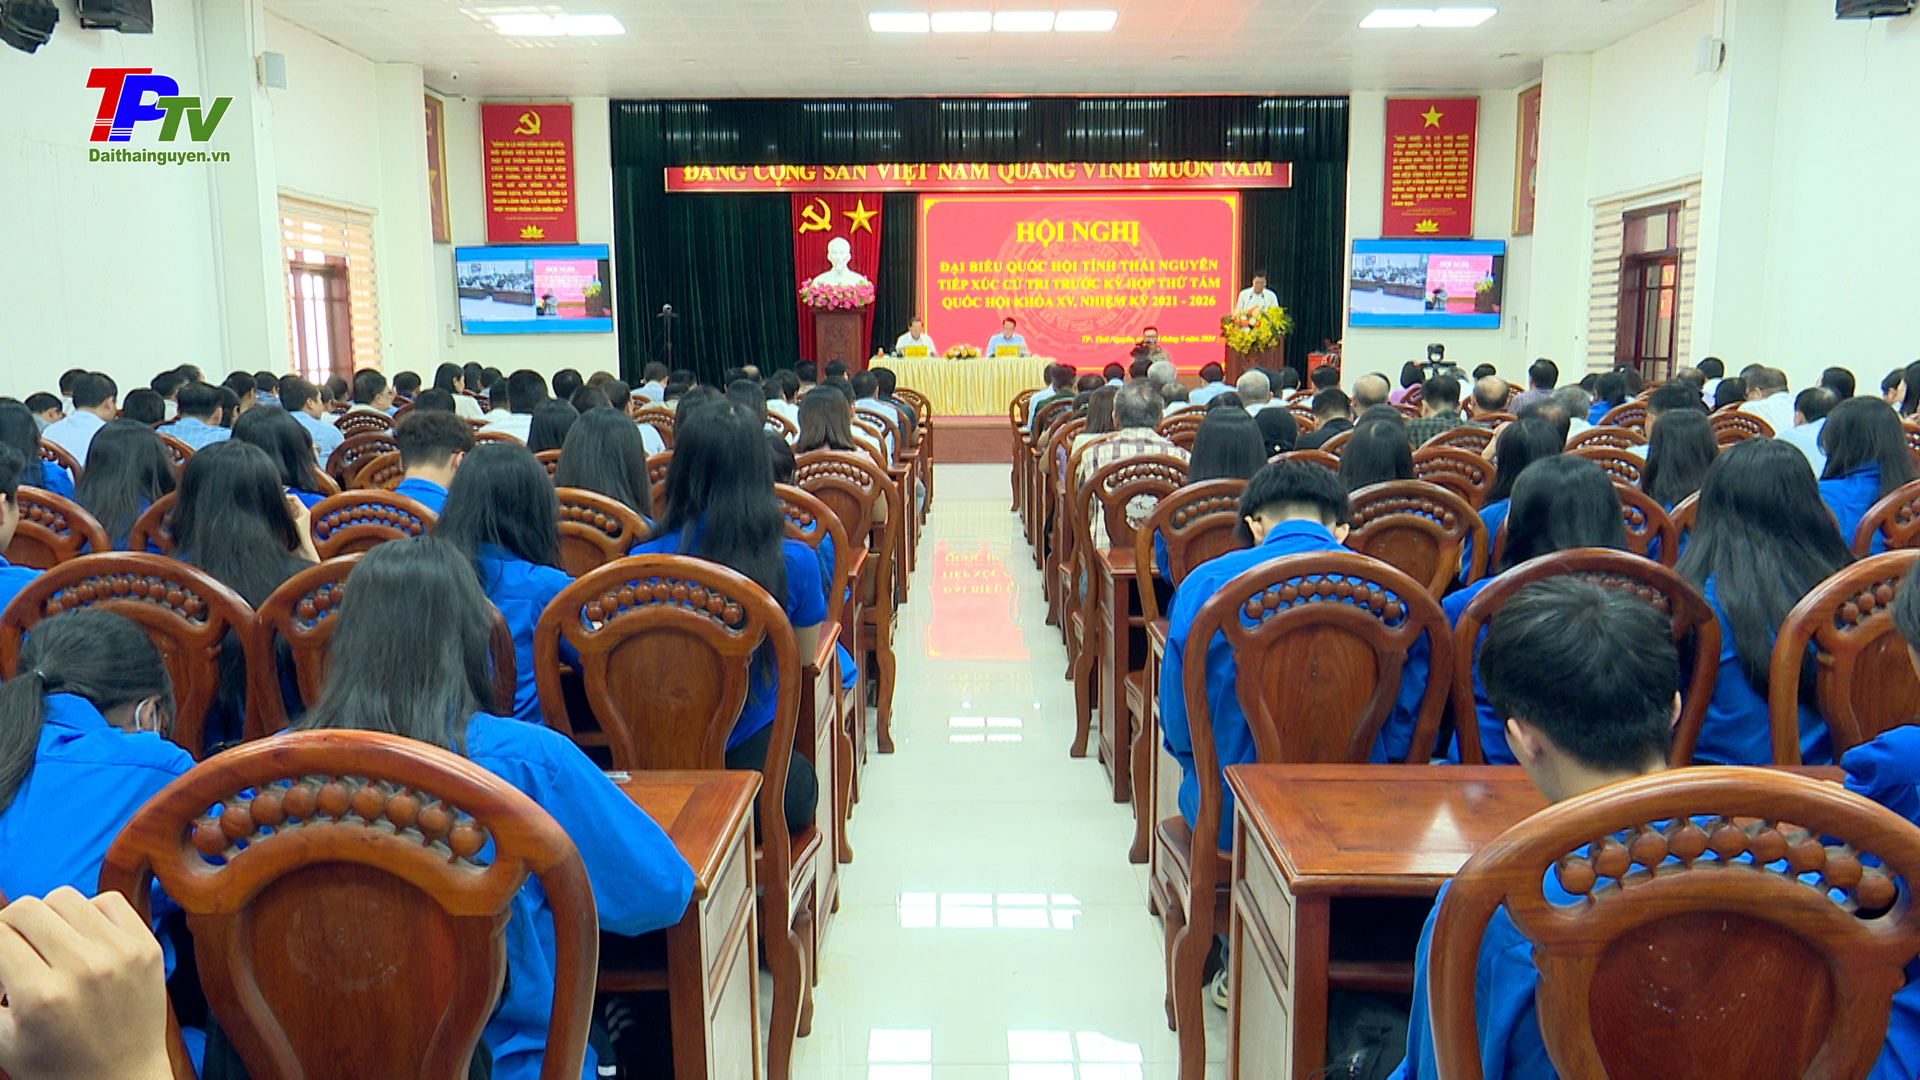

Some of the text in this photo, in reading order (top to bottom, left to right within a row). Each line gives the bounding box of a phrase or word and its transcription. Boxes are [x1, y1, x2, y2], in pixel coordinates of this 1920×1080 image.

[937, 163, 991, 180] NAM
[997, 162, 1077, 184] QUANG
[1082, 162, 1142, 179] VINH
[1016, 218, 1140, 248] HỘI NGHỊ
[940, 260, 965, 276] ĐẠI
[1006, 257, 1048, 274] QUỐC
[1051, 259, 1078, 274] HỘI
[1119, 257, 1155, 272] THÁI
[1159, 257, 1219, 272] NGUYÊN
[937, 277, 969, 290] TIẾP
[971, 275, 1000, 290] XÚC
[1026, 279, 1049, 290] TRI
[1126, 277, 1156, 292] HỌP
[1189, 275, 1221, 289] TÁM
[942, 293, 982, 310] QUỐC
[985, 295, 1011, 309] HỘI
[1013, 293, 1054, 308] KHÓA
[1056, 295, 1078, 308] XV,
[1080, 295, 1126, 310] NHIỆM
[1151, 295, 1178, 307] 2021
[1188, 295, 1217, 307] 2026
